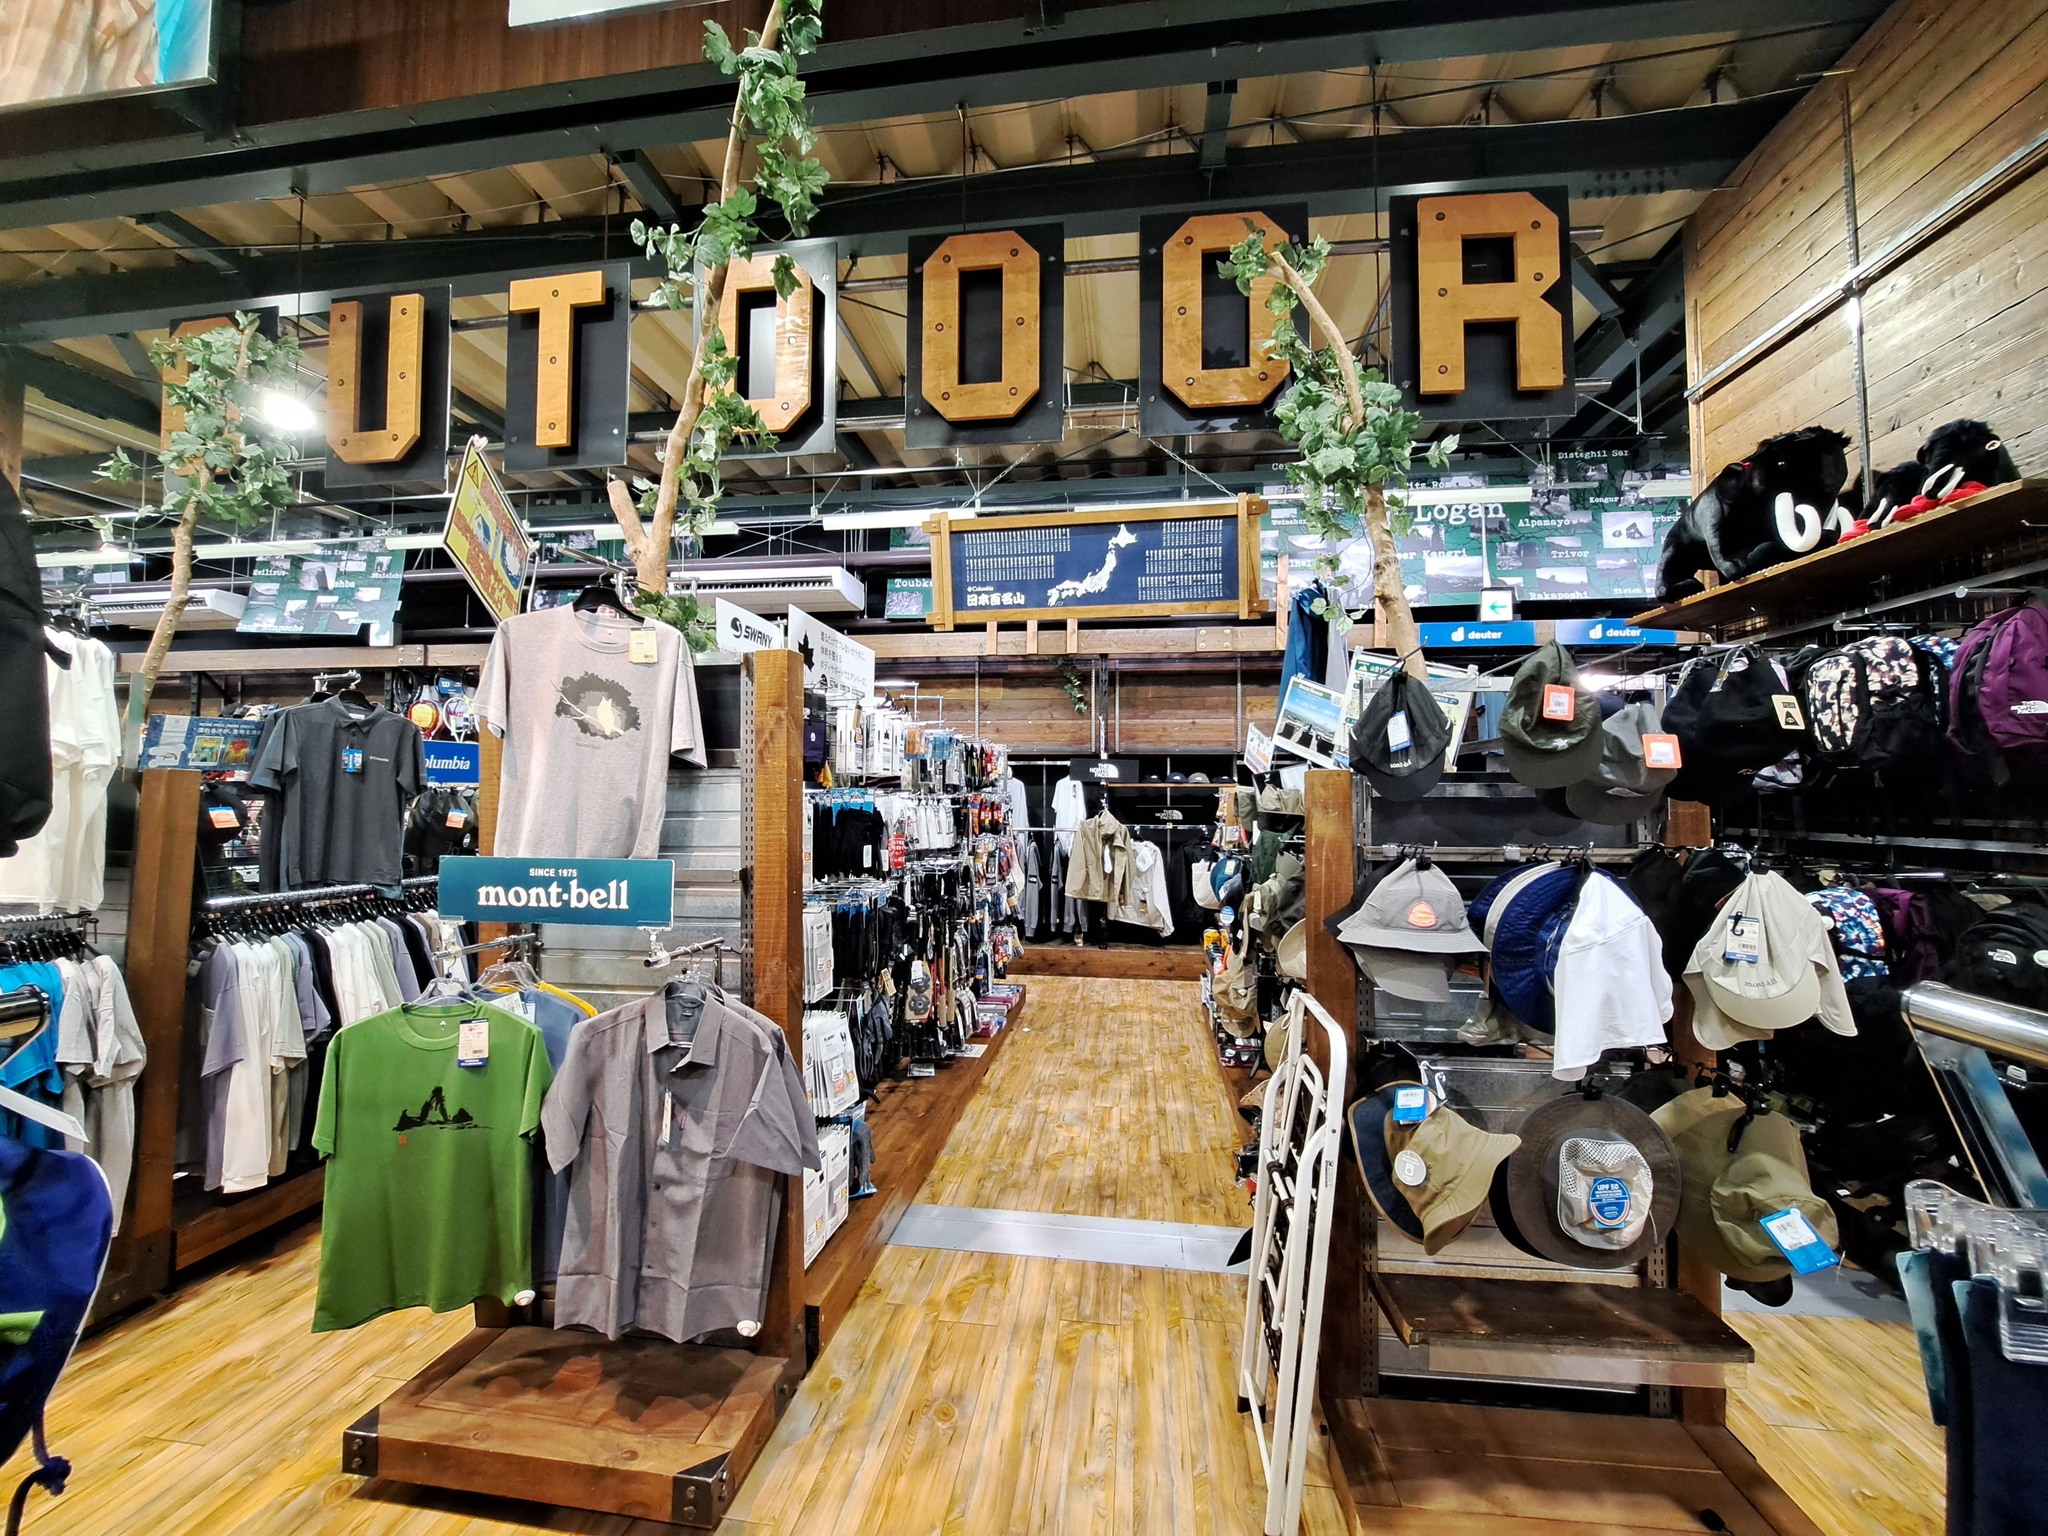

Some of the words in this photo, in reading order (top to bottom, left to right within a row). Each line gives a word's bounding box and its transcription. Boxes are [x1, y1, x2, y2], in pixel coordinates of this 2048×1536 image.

[1413, 503, 1506, 525] Logan
[1517, 518, 1571, 528] Alpamayo
[1422, 548, 1468, 559] Kangri
[1550, 550, 1590, 559] Trivor
[894, 578, 934, 588] Toubka
[966, 591, 1026, 607] 日本百名山
[1528, 590, 1590, 600] Rakaposhi
[743, 624, 773, 649] SWANY
[1467, 630, 1503, 640] deuter
[1606, 627, 1642, 638] deuter
[424, 754, 471, 770] olumbia
[529, 868, 556, 877] SINCE
[558, 868, 577, 878] 1975
